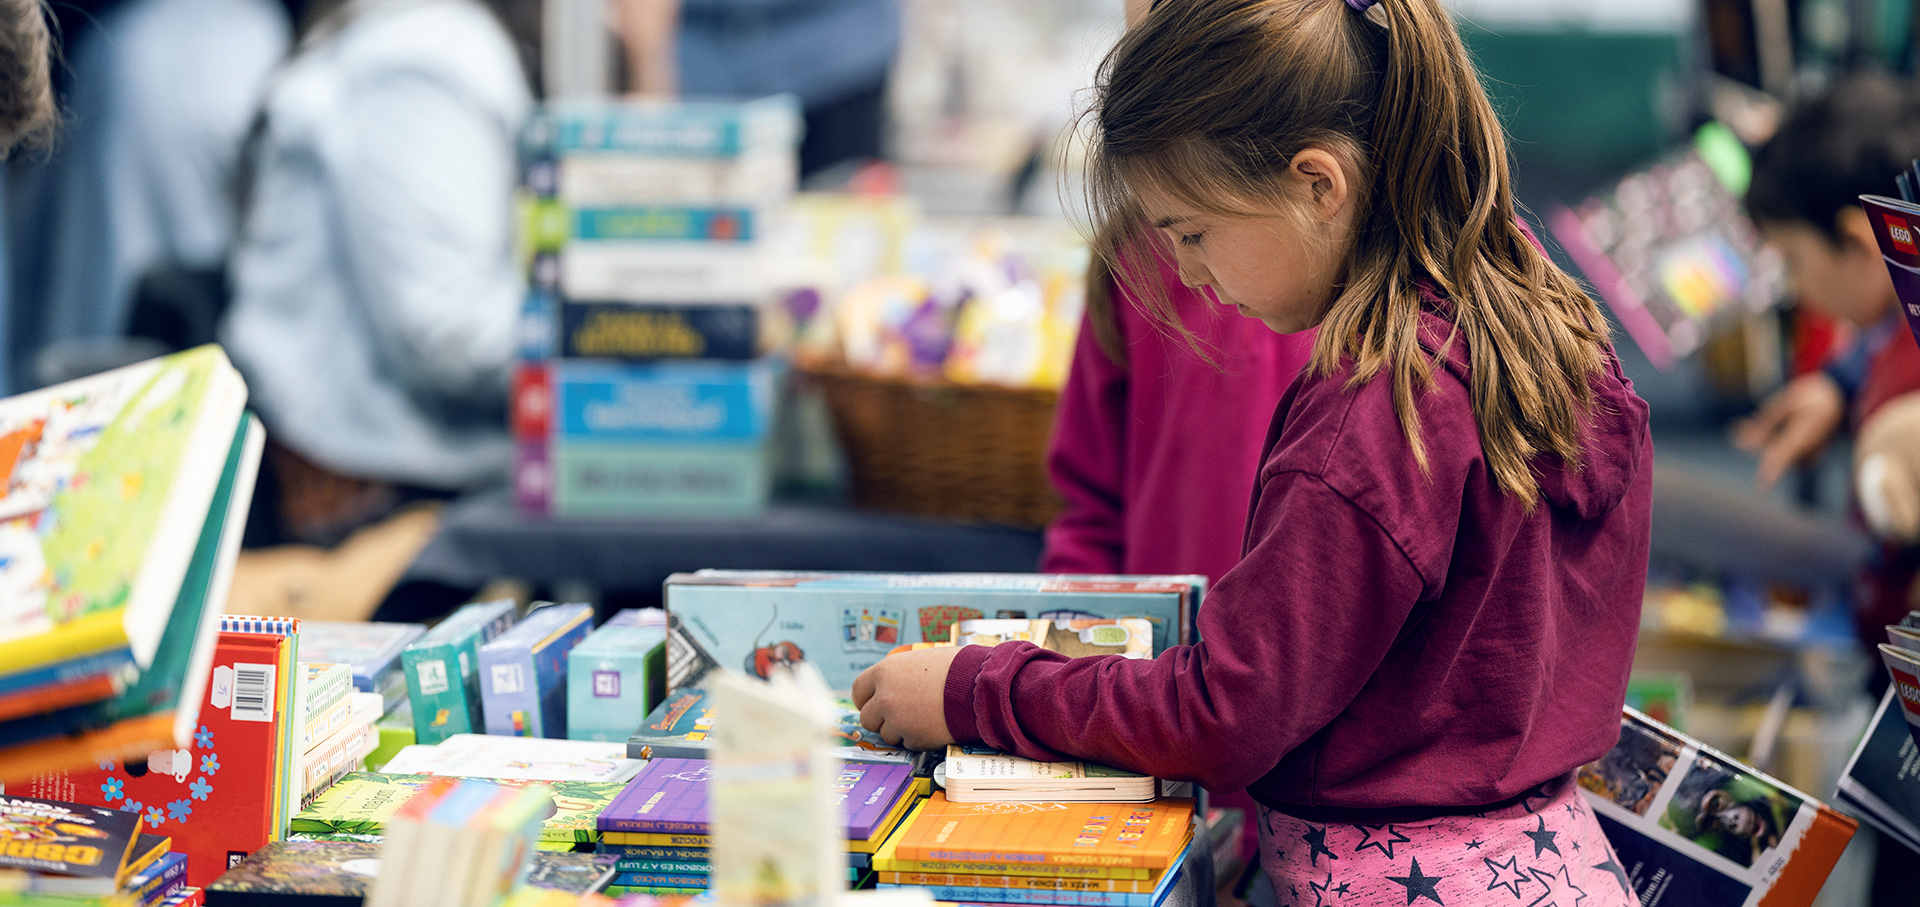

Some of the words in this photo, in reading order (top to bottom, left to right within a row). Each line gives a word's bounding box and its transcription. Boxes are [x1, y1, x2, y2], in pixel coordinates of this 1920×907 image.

[1890, 226, 1911, 243] LEGO
[624, 848, 665, 856] BAJNOK
[675, 850, 716, 860] ORIBON,
[994, 853, 1002, 861] A
[1004, 853, 1045, 862] BORIBON
[619, 861, 640, 870] LUFI
[641, 862, 649, 870] 7
[660, 863, 674, 873] ÉS
[963, 863, 1007, 872] BORIBON
[632, 875, 667, 885] MACKÓI
[668, 876, 708, 886] BORIBON
[1640, 867, 1666, 907] nline.hu
